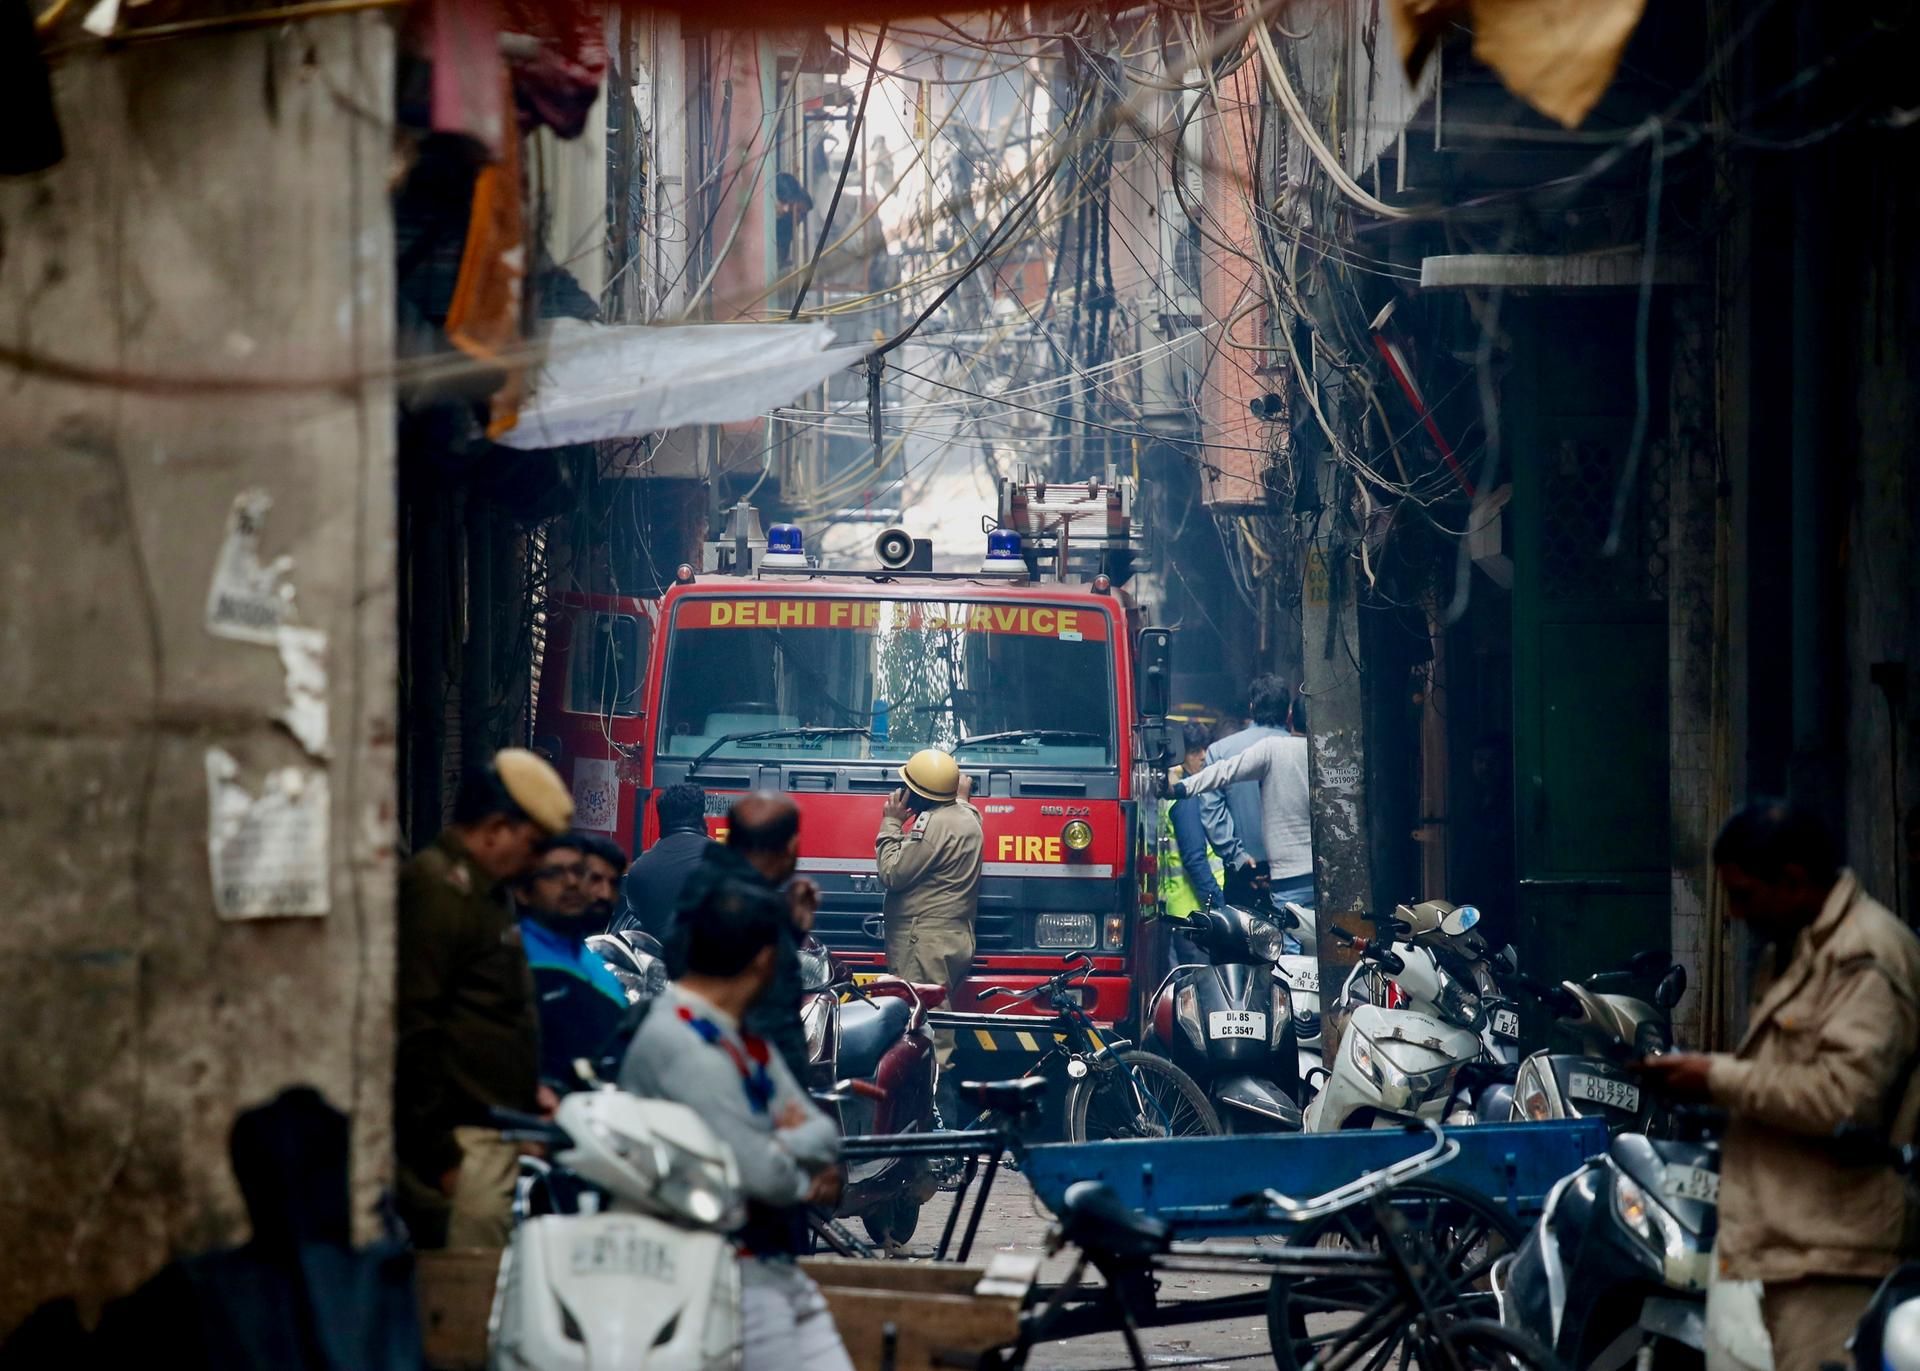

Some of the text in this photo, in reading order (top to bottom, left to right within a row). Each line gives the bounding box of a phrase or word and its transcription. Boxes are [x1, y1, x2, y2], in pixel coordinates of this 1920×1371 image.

[710, 602, 816, 626] DELHI
[931, 602, 1078, 634] RVICE
[998, 835, 1061, 862] FIRE
[1226, 1013, 1237, 1021] DL
[1222, 1026, 1233, 1035] CE
